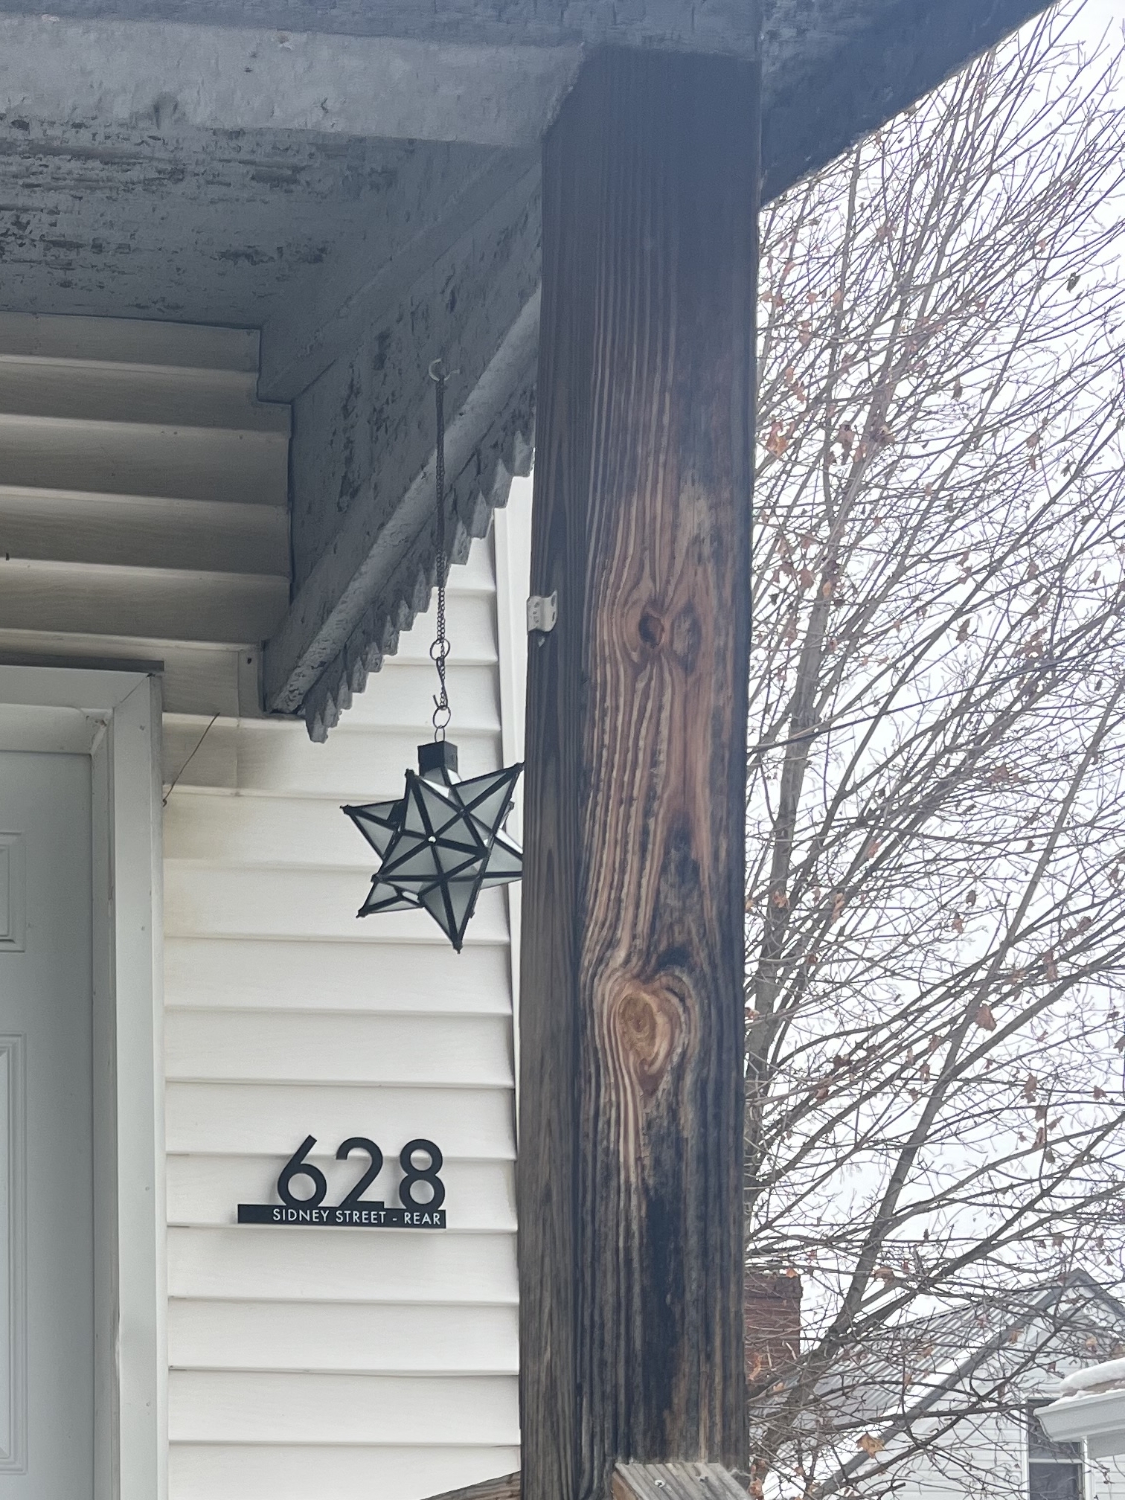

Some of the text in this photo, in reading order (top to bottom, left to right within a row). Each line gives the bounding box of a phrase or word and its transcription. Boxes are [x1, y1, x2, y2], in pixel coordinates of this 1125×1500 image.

[277, 1134, 446, 1211] 628
[272, 1208, 330, 1223] SIDNEY
[335, 1210, 387, 1224] STREET
[404, 1212, 441, 1225] REAR
